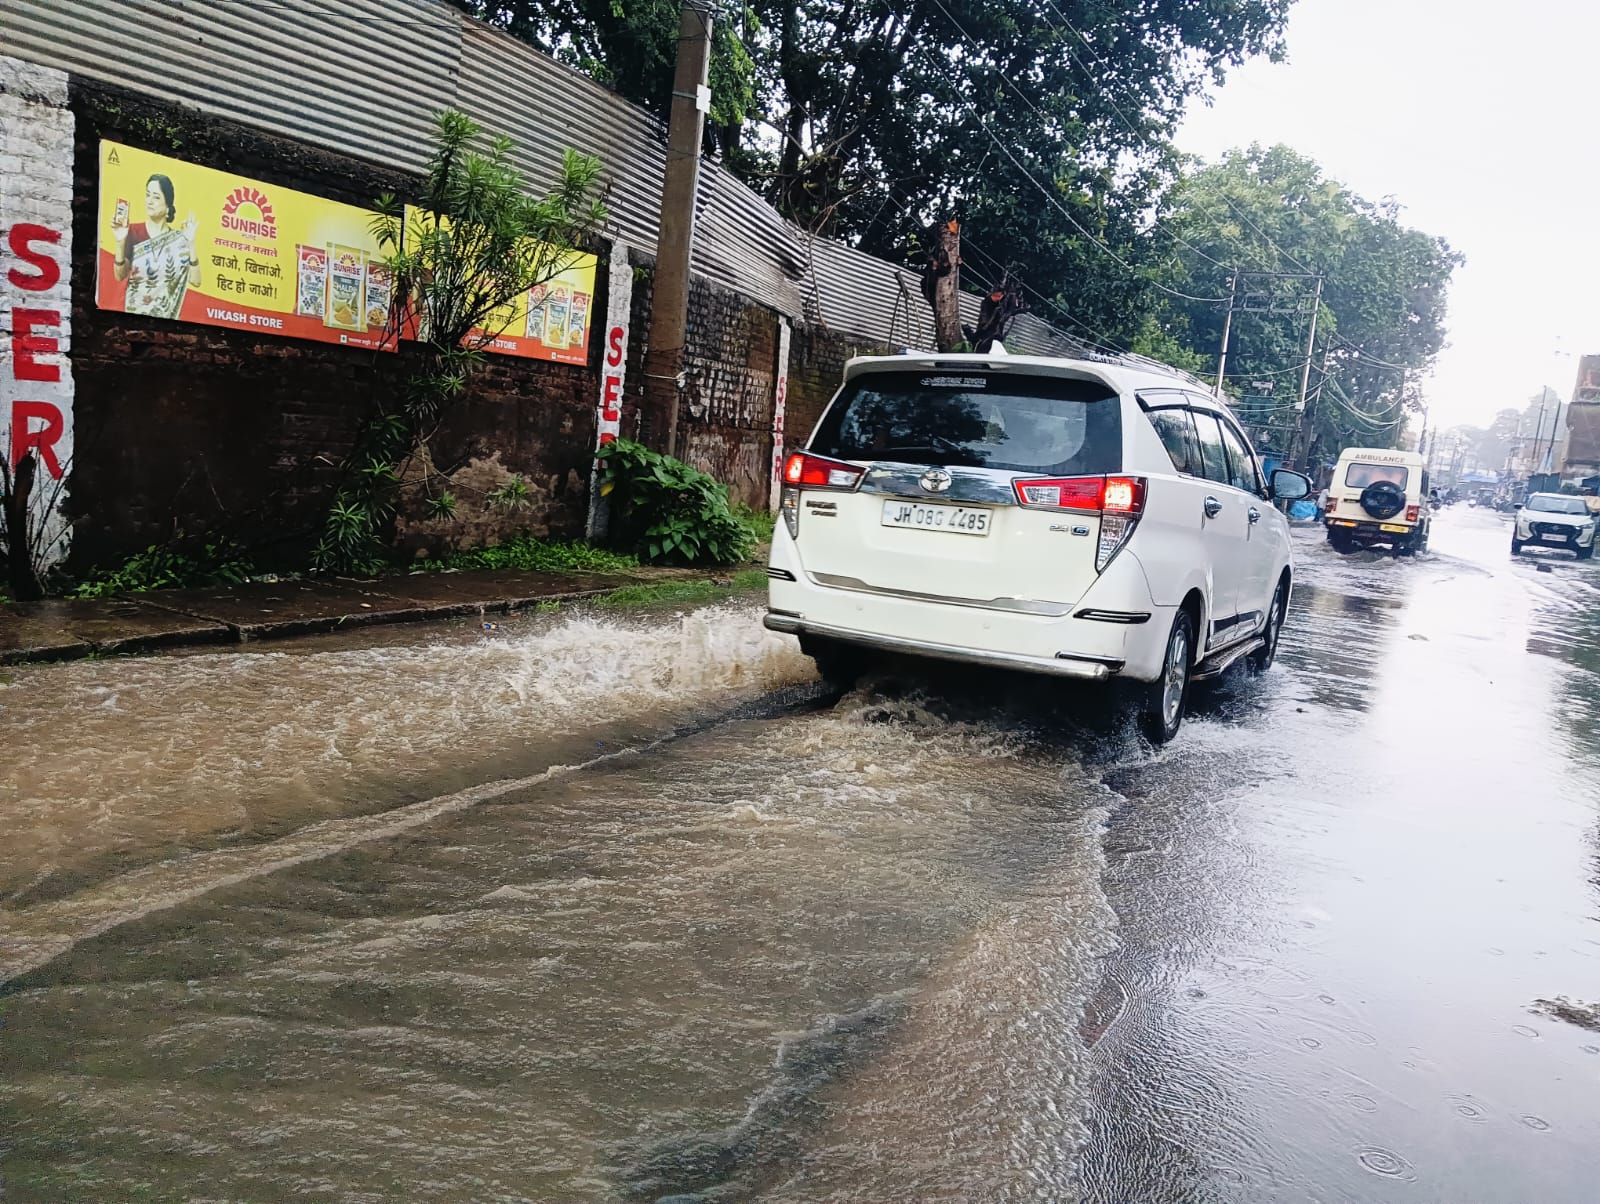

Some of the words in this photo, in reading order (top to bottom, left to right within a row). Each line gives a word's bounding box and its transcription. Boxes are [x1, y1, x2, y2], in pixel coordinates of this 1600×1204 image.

[221, 215, 277, 239] SUNRISE
[333, 263, 361, 276] SUNRISE
[217, 273, 233, 291] हिट
[235, 277, 246, 293] हो
[206, 307, 247, 323] VIKASH
[249, 315, 283, 329] STORE
[1355, 454, 1405, 463] AMBULANCE
[894, 507, 912, 523] JH
[949, 512, 987, 530] 4485
